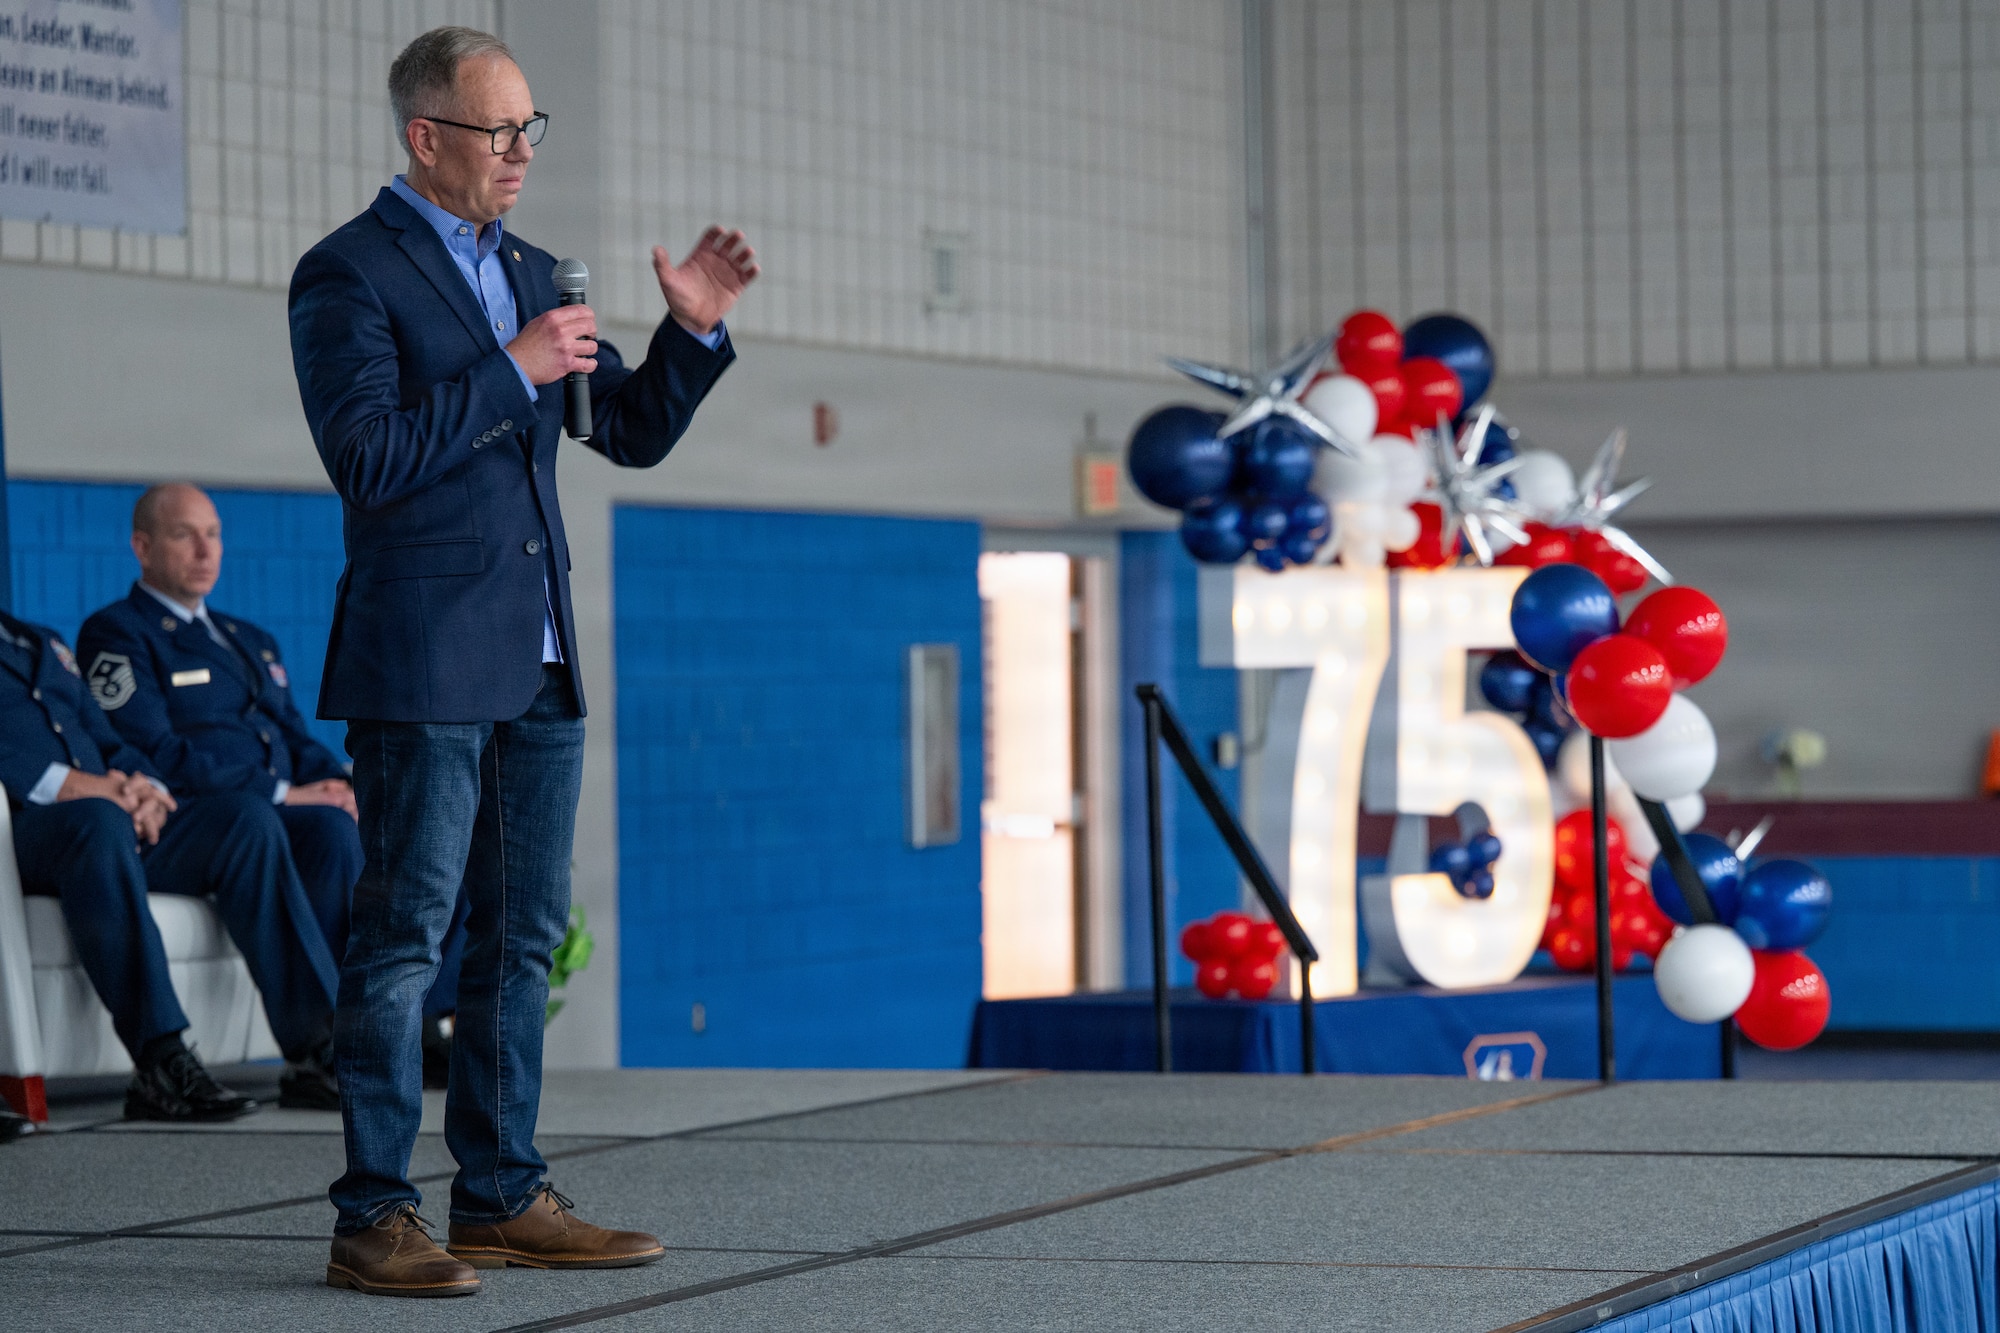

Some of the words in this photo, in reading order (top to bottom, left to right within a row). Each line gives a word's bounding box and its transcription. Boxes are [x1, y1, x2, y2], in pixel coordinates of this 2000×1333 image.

[21, 12, 77, 53] Leader,
[80, 21, 139, 58] Warrior.
[39, 68, 57, 93] an
[61, 63, 112, 101] Airman
[117, 72, 172, 111] behind.
[18, 114, 60, 142] never
[22, 155, 49, 187] will
[52, 164, 78, 193] not
[80, 160, 111, 195] fail.
[1222, 565, 1556, 1001] 75
